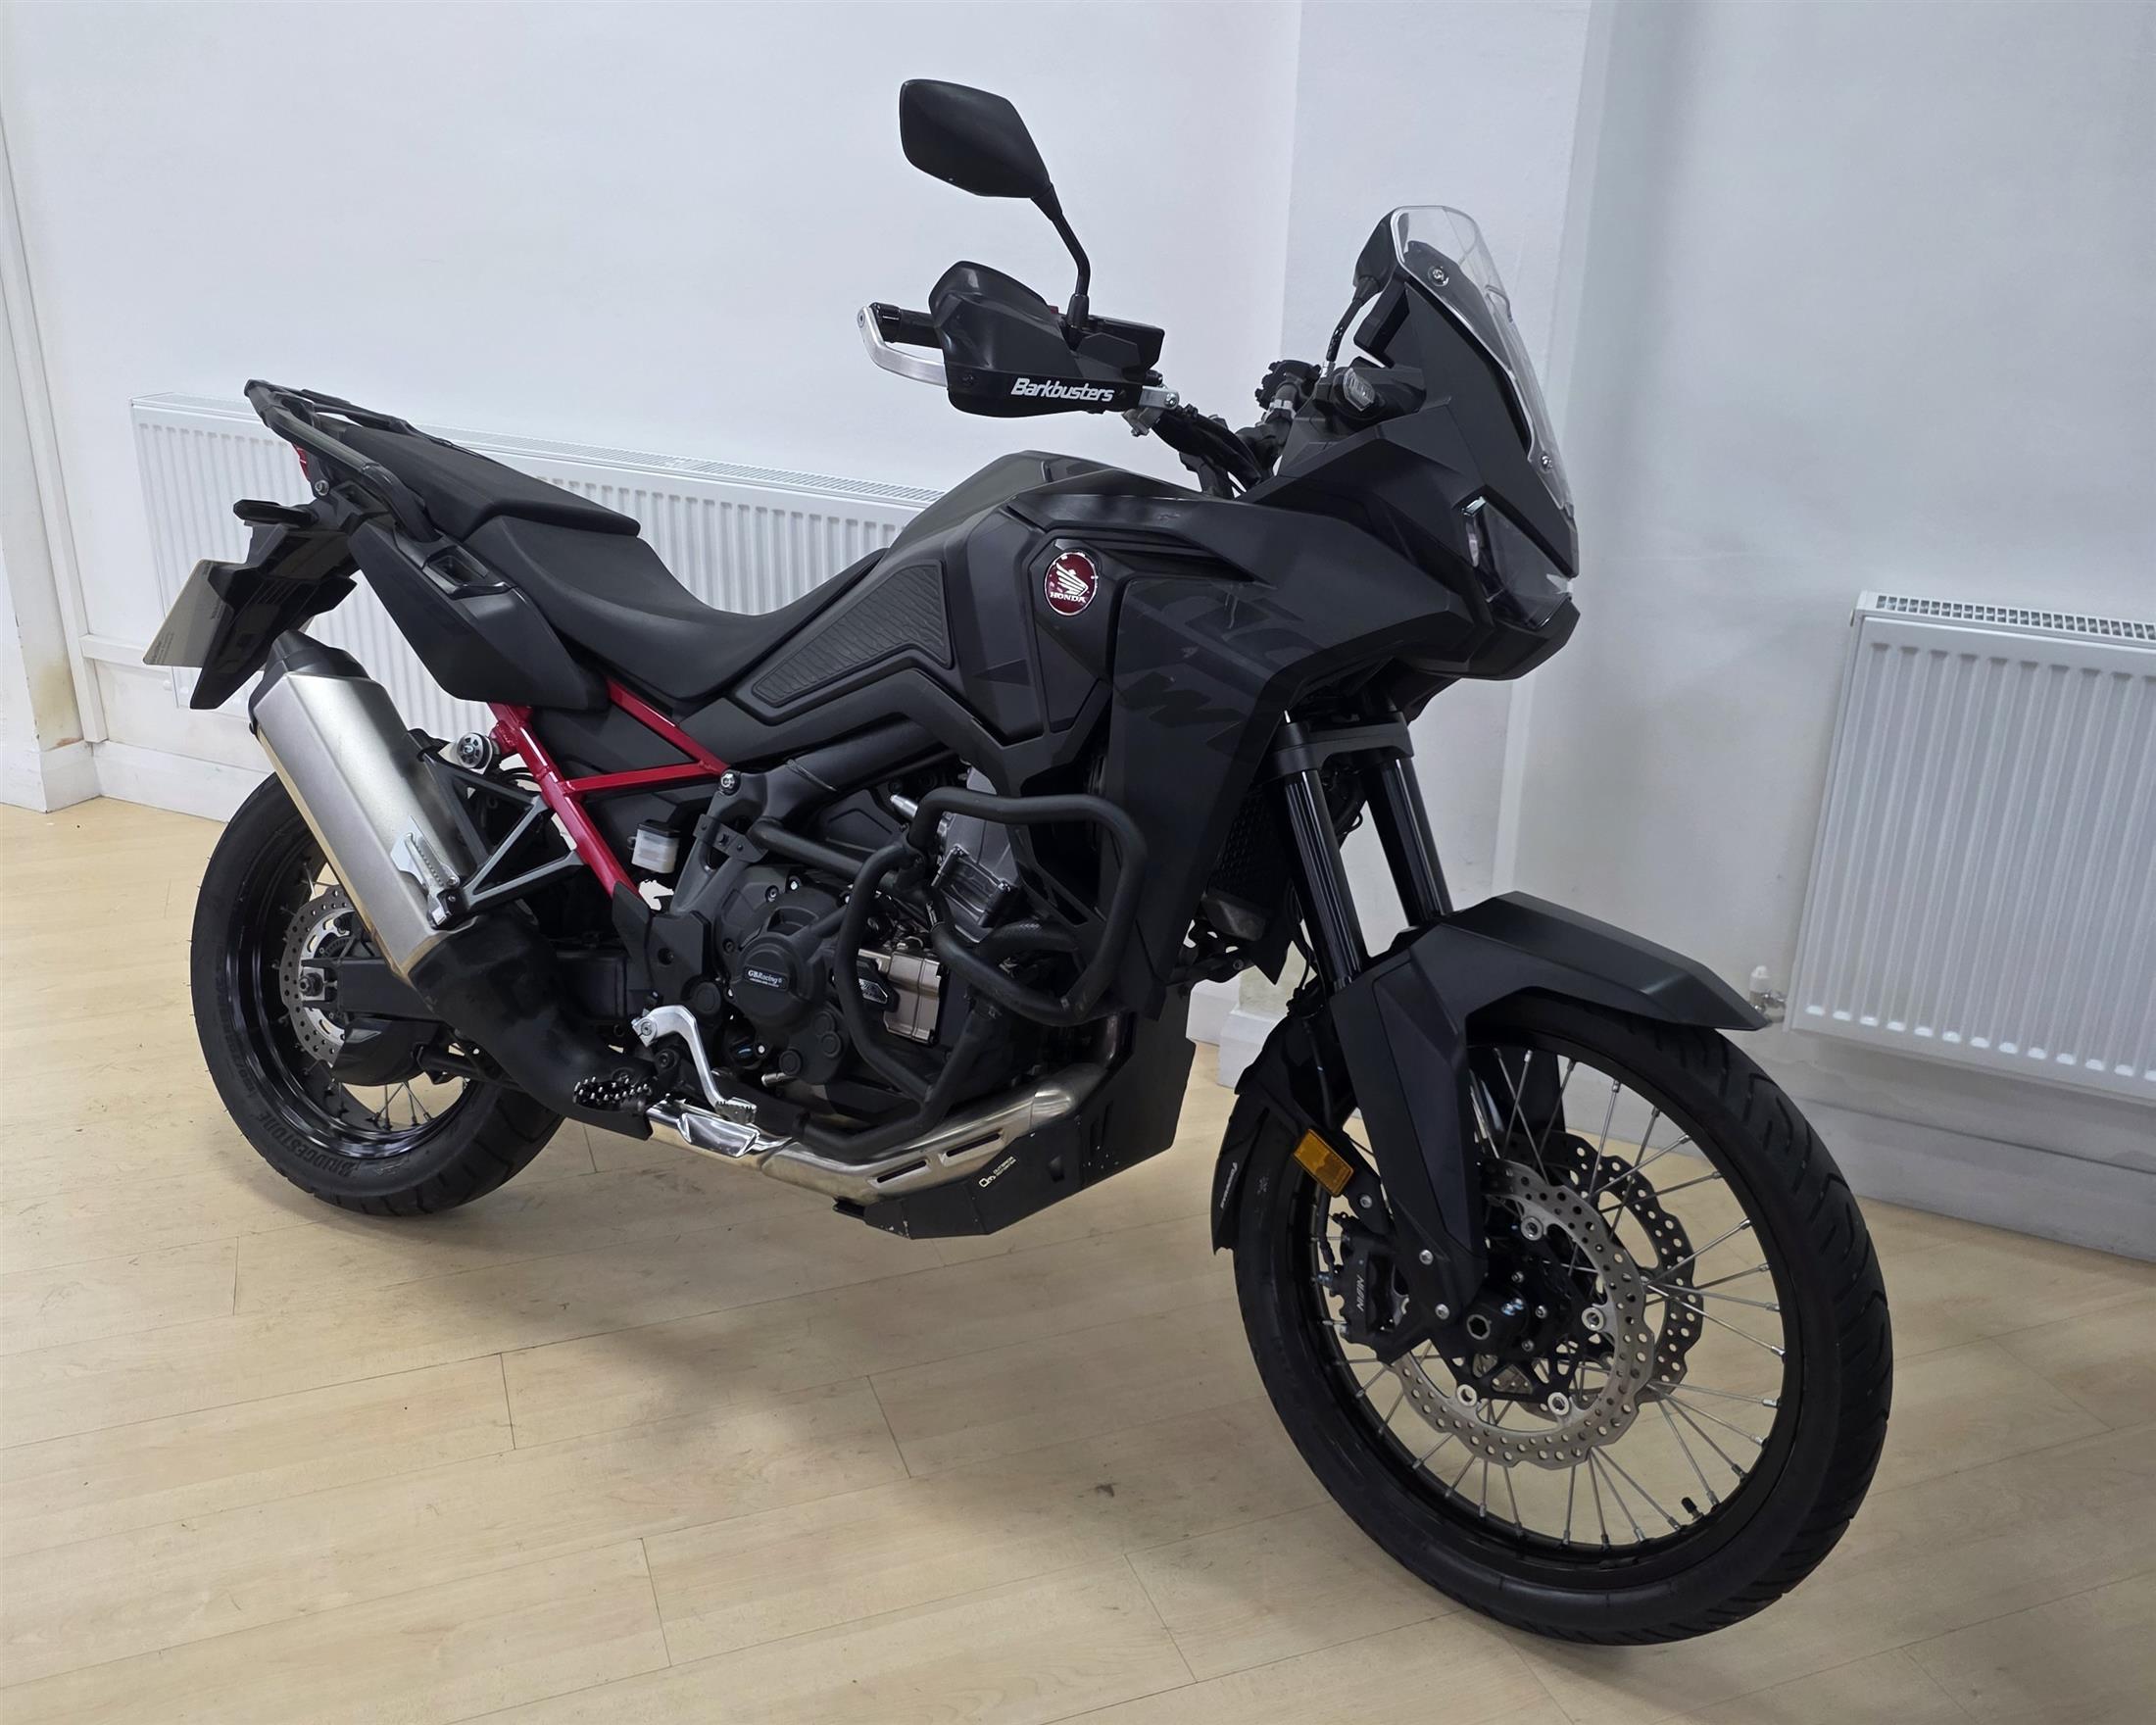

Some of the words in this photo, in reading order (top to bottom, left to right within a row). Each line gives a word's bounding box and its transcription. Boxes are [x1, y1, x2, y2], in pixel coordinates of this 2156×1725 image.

[1010, 376, 1115, 402] Barkbusters
[1050, 591, 1087, 604] HONDA
[257, 1111, 358, 1177] BRIDGESTONE
